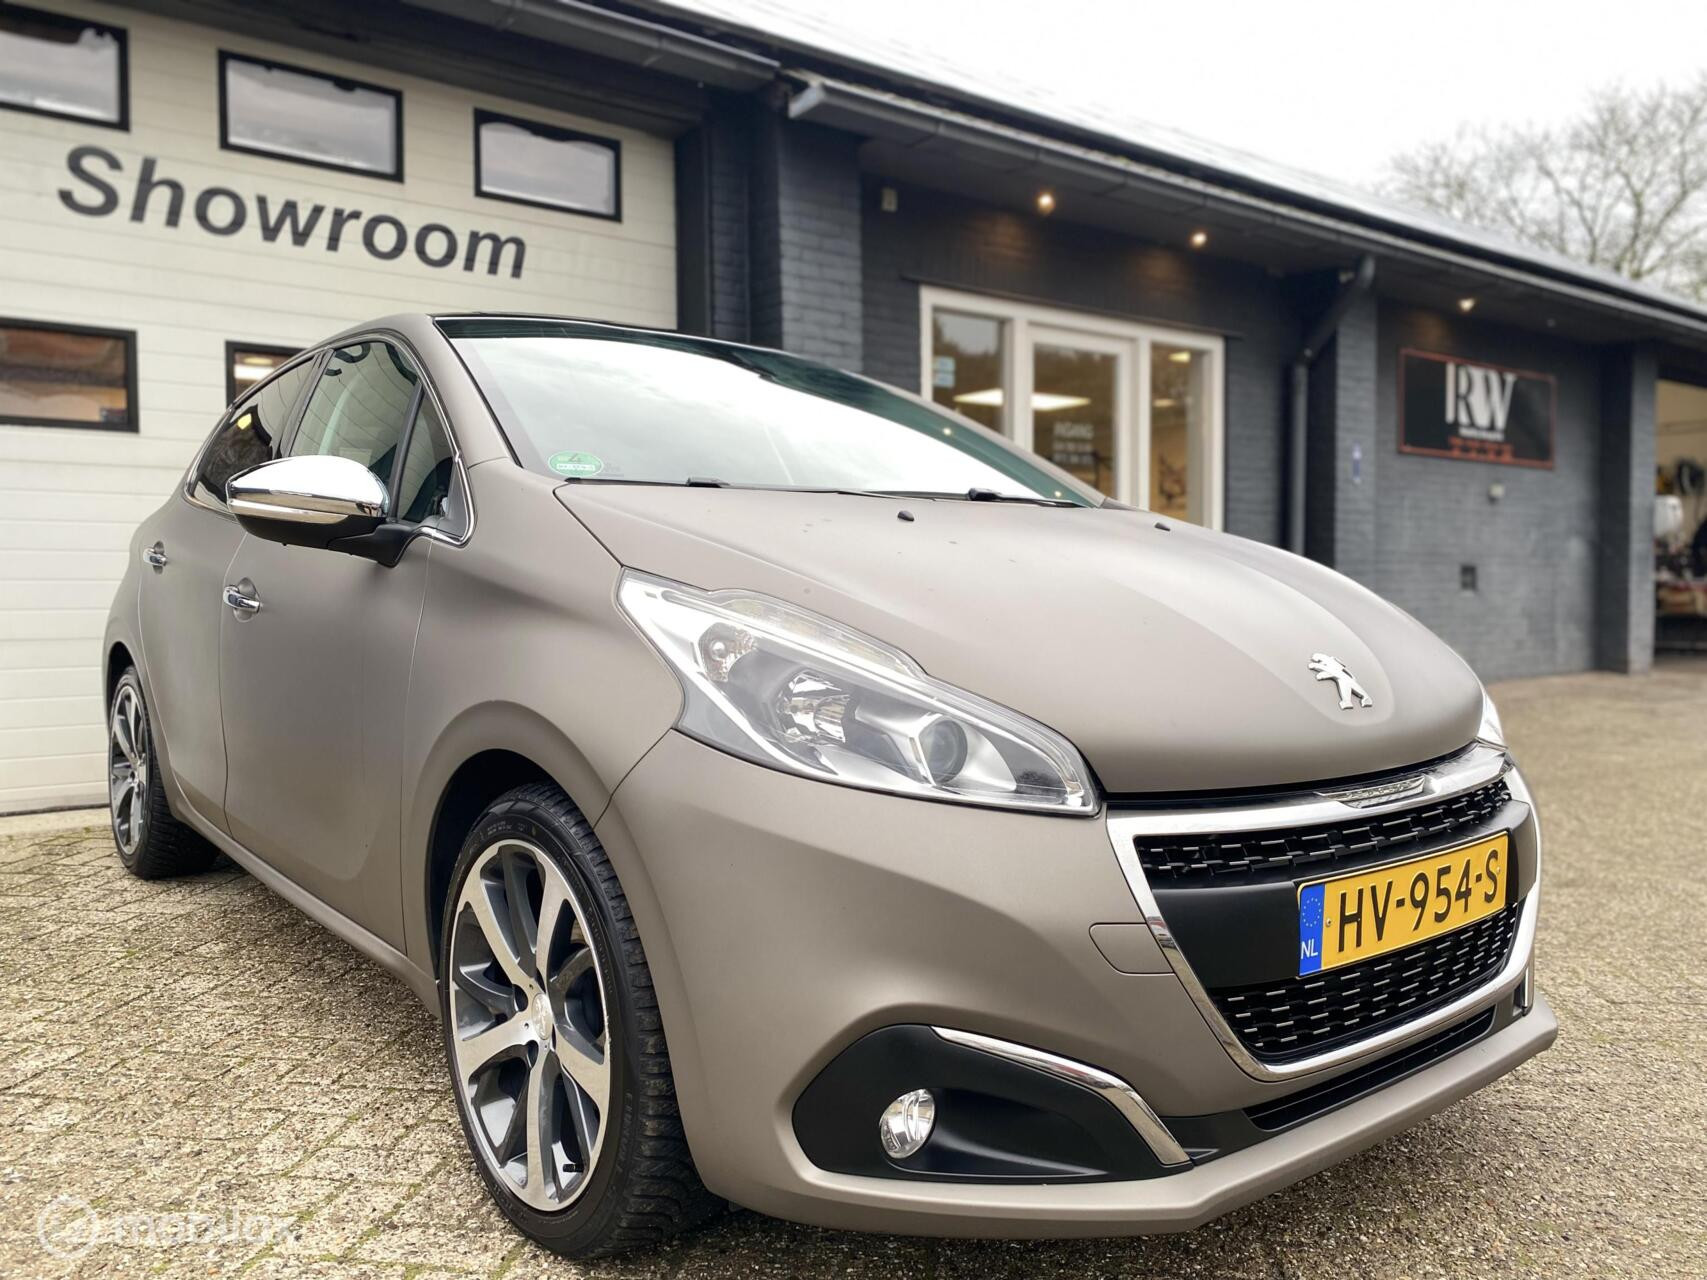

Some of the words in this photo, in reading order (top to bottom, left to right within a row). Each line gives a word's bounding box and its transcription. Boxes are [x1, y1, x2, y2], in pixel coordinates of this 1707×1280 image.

[57, 145, 527, 279] Showroom
[1300, 938, 1319, 960] NL
[1338, 849, 1499, 953] HV-954-S
